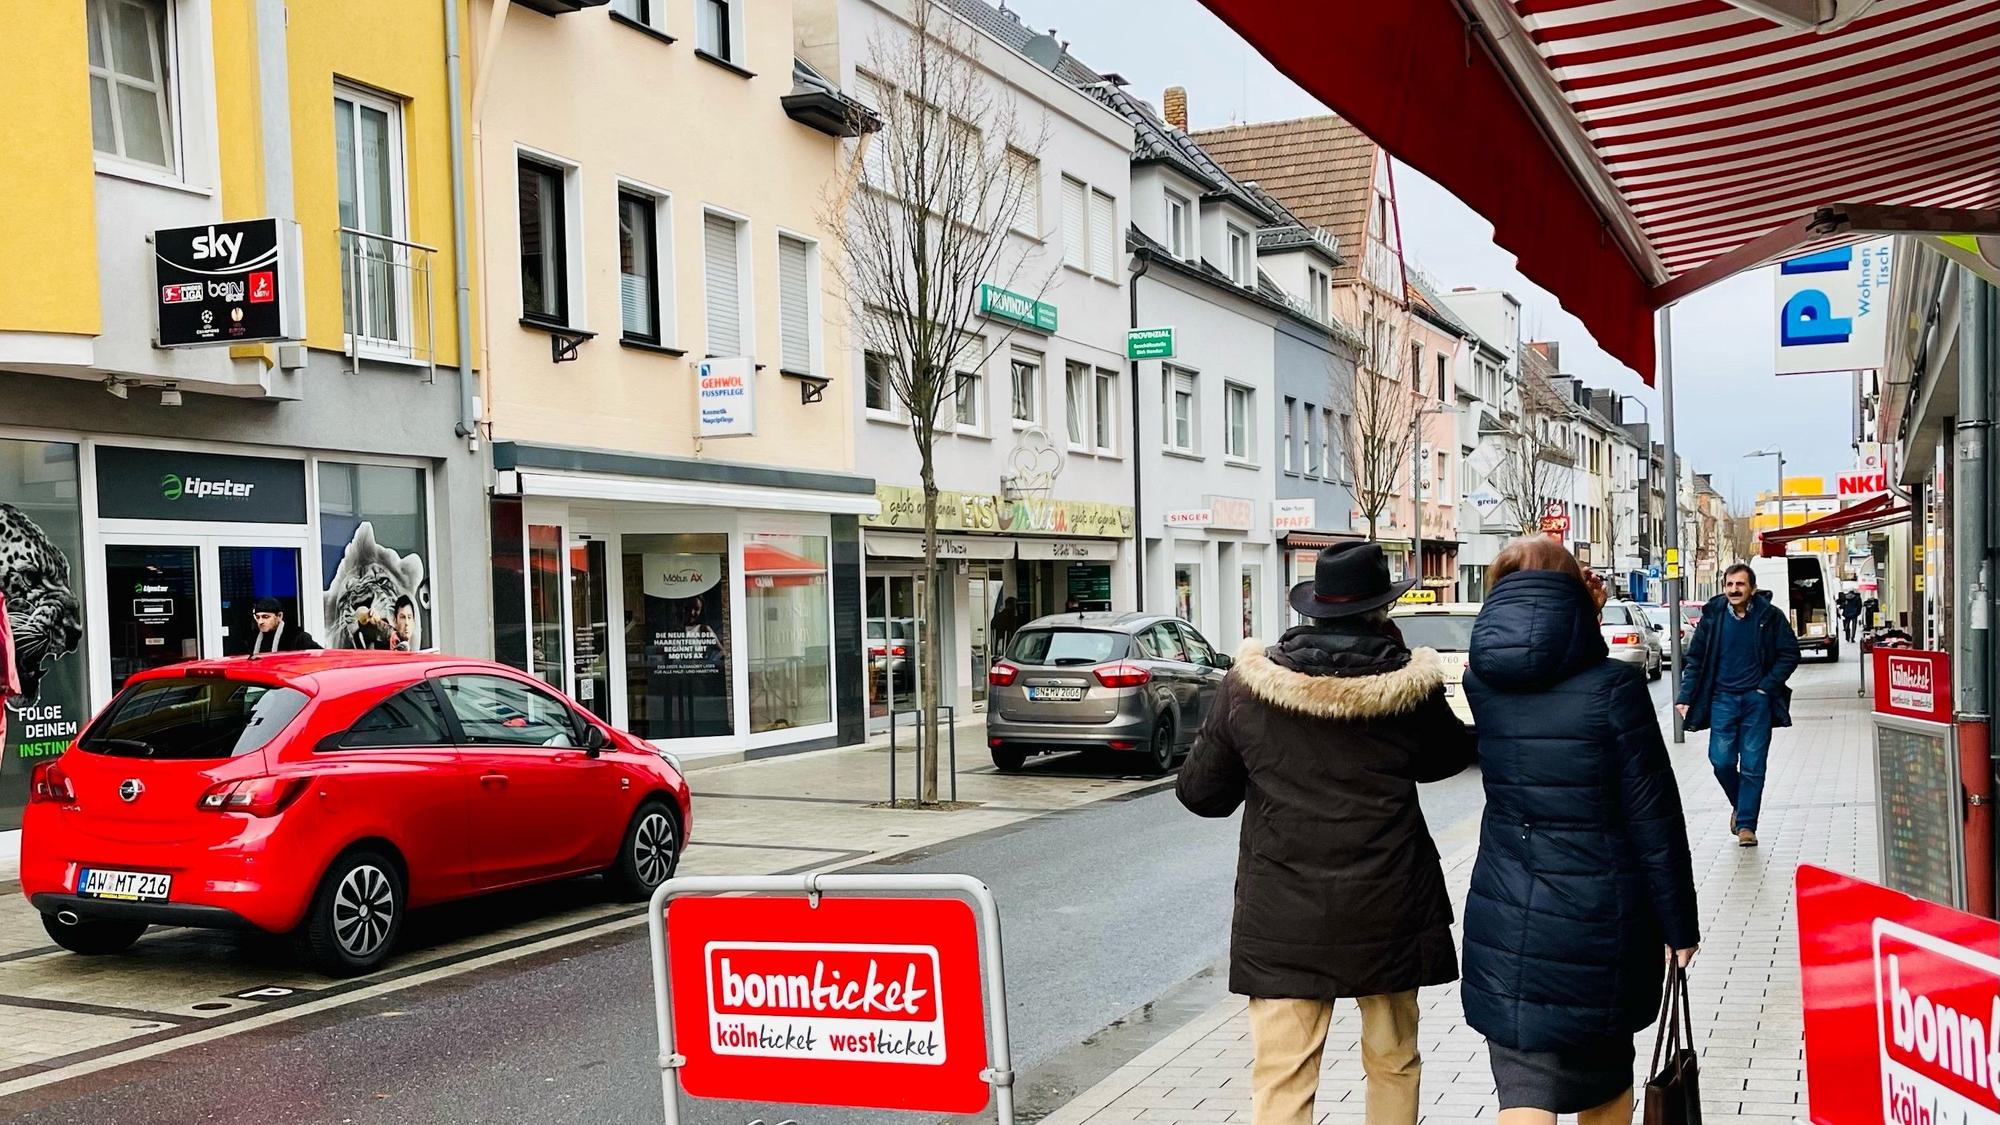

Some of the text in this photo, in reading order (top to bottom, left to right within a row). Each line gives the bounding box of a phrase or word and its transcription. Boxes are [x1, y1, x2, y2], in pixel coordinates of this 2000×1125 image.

[192, 226, 244, 264] sky
[1876, 247, 1889, 287] Tisch
[1858, 247, 1871, 317] Wohnen
[987, 289, 1035, 319] PROVINZIAL
[1129, 330, 1170, 340] PROVINZIAL
[702, 376, 743, 389] GEHWOL
[702, 388, 744, 397] FUSSPFLEGE
[184, 477, 254, 498] tipster
[1171, 513, 1209, 522] SINGER
[1276, 516, 1310, 528] PFAFF
[690, 573, 703, 582] AX
[653, 638, 717, 646] HAARENTFERNUNG
[668, 652, 692, 660] MOTUS
[1892, 663, 1930, 690] kölnticket
[19, 705, 62, 721] FOLGE
[25, 721, 77, 738] DEINEM
[87, 872, 166, 895] AW MT 216
[721, 957, 928, 1014] bonnticket
[717, 1022, 938, 1056] kölnticket westticket
